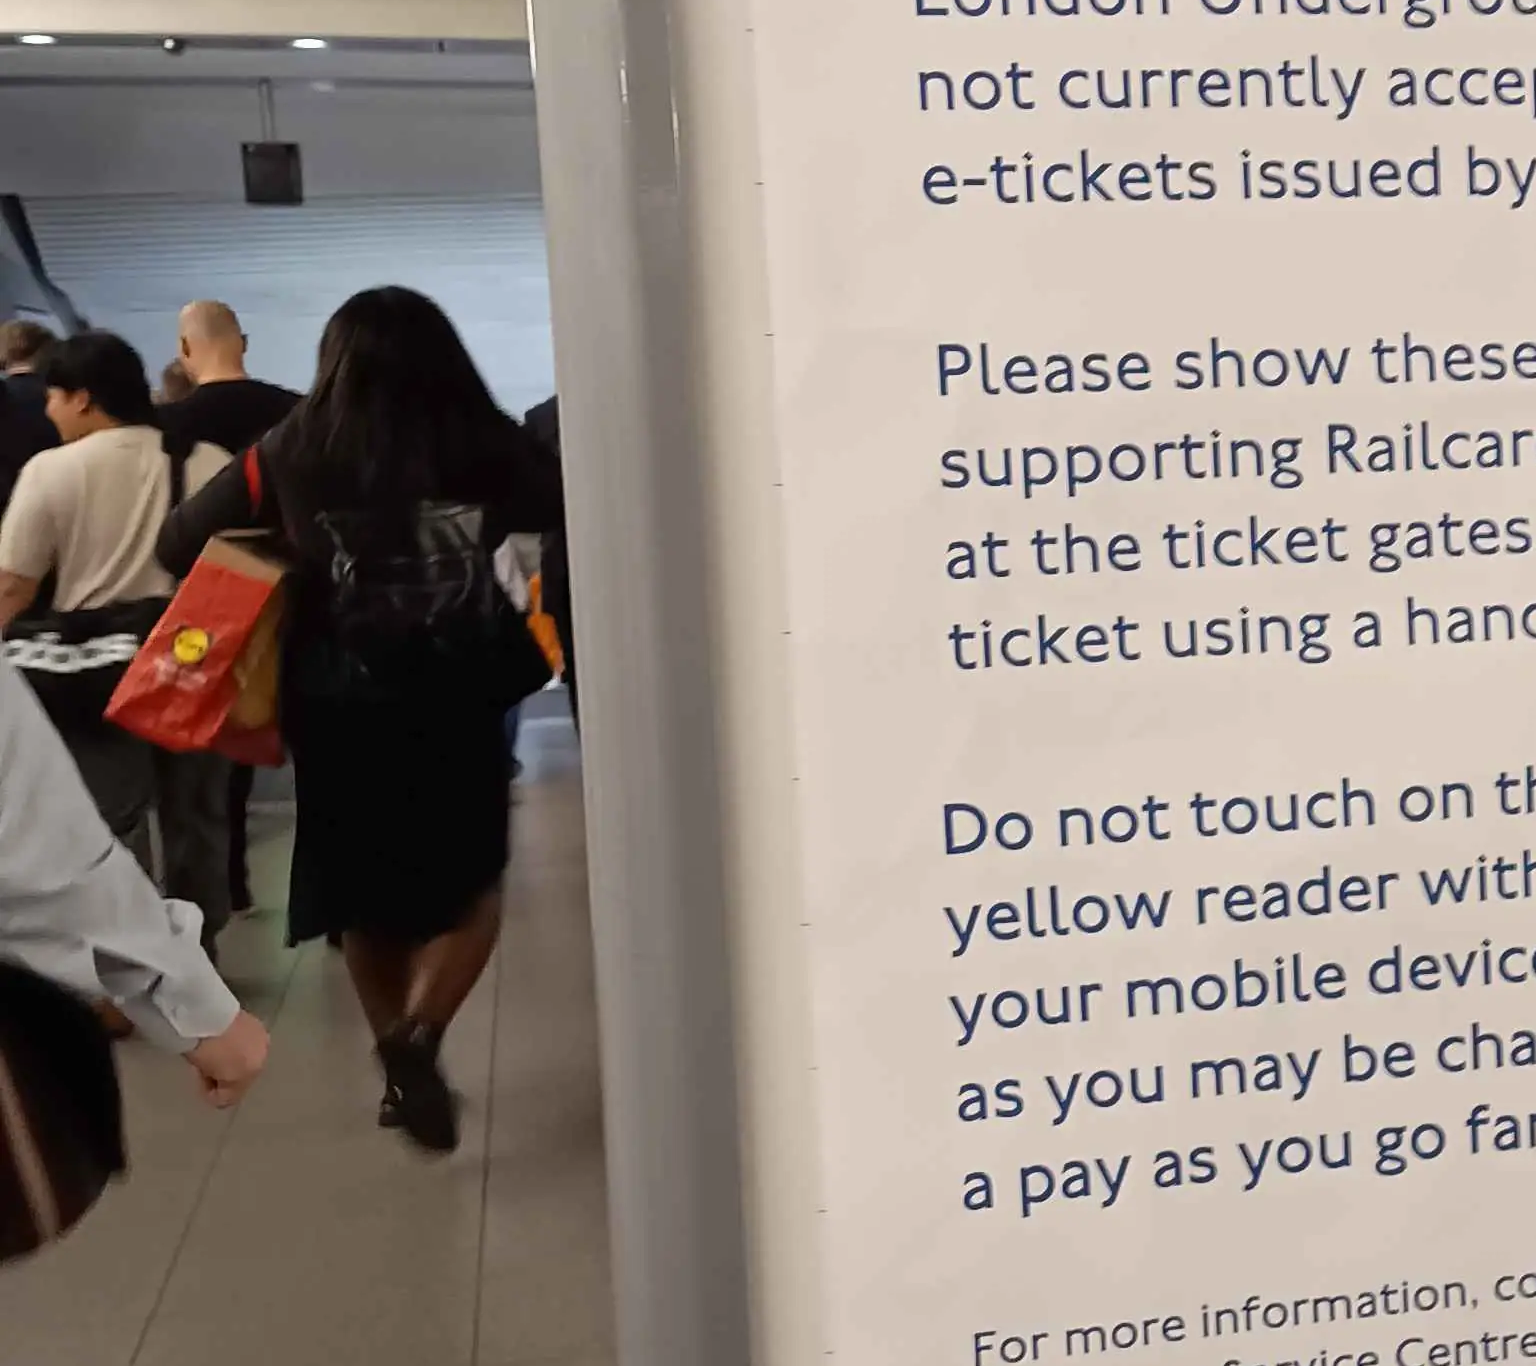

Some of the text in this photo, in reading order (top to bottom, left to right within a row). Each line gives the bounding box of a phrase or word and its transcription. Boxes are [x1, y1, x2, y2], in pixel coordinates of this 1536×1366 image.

[918, 62, 1035, 111] not
[1059, 55, 1366, 120] currently
[922, 149, 1217, 205] e-tickets
[1240, 145, 1441, 202] issued
[937, 343, 1152, 396] Please
[1175, 337, 1350, 389] show
[940, 429, 1304, 499] supporting
[944, 532, 1011, 579] at
[1030, 523, 1141, 575] the
[1162, 515, 1349, 569] ticket
[948, 614, 1141, 670] ticket
[1164, 606, 1332, 664] using
[1352, 611, 1382, 648] a
[943, 803, 1033, 855] Do
[1058, 795, 1171, 847] not
[1188, 777, 1375, 837] touch
[1399, 783, 1473, 822] on
[943, 885, 1173, 958] yellow
[1195, 865, 1400, 925] reader
[948, 983, 1103, 1047] your
[1126, 952, 1347, 1018] mobile
[957, 1079, 1024, 1122] as
[1044, 1066, 1164, 1126] you
[1190, 1049, 1322, 1101] may
[1344, 1033, 1415, 1082] be
[962, 1172, 994, 1211] a
[1020, 1155, 1132, 1218] pay
[1153, 1146, 1218, 1189] as
[1238, 1131, 1352, 1192] you
[1375, 1123, 1446, 1176] go
[1066, 1316, 1186, 1356] more
[1201, 1280, 1478, 1338] information,
